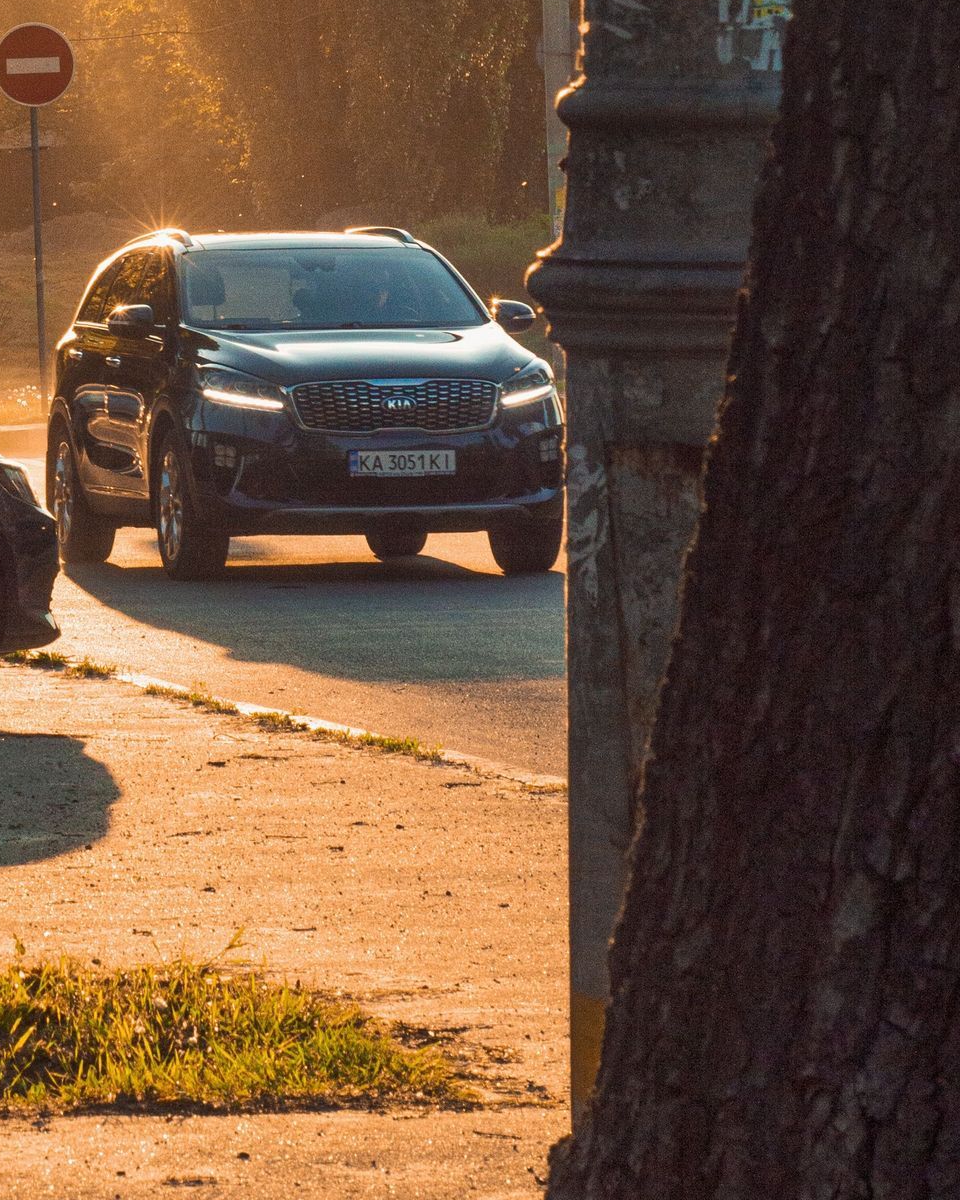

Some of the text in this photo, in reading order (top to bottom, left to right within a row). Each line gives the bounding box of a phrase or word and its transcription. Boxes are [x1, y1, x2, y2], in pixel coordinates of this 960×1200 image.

[387, 399, 412, 410] KIA
[359, 453, 450, 471] KA 3051 KI
